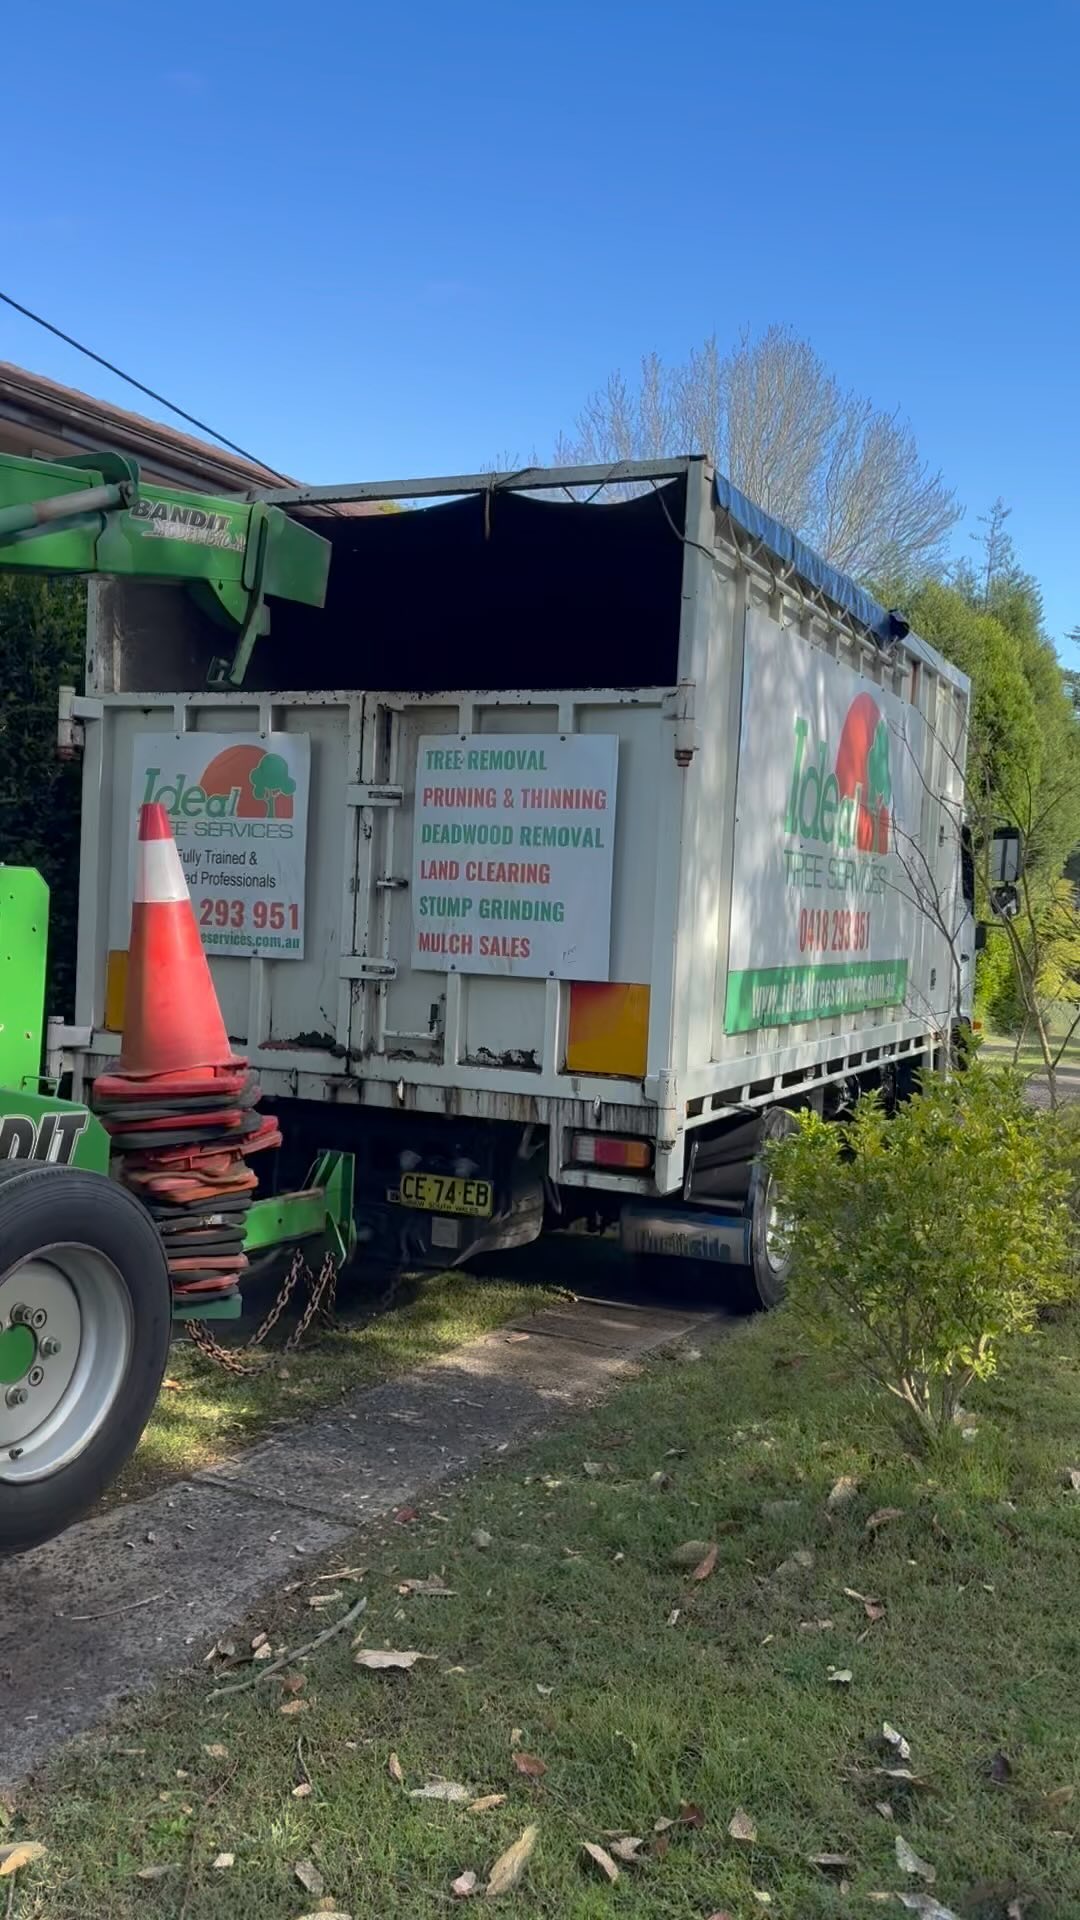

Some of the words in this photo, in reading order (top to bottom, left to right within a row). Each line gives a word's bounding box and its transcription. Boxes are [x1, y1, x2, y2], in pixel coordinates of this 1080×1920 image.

[129, 498, 232, 530] BANDIT
[426, 750, 462, 770] TREE
[467, 750, 548, 770] REMOVAL
[138, 768, 241, 818] Ideal
[784, 716, 863, 848] Ideal
[423, 787, 497, 808] PRUNING
[503, 788, 515, 809] &
[521, 788, 608, 810] THINNING
[194, 821, 294, 839] SERVICES
[421, 823, 514, 845] DEADWOOD
[519, 825, 605, 848] REMOVAL
[176, 848, 201, 866] Fully
[205, 849, 246, 865] Trained
[249, 851, 258, 865] &
[783, 849, 824, 889] TREE
[201, 871, 277, 888] Professionals
[420, 860, 460, 881] LAND
[465, 861, 551, 884] CLEARING
[200, 898, 245, 928] 293
[253, 900, 299, 930] 951
[419, 896, 473, 917] STUMP
[479, 898, 565, 922] GRINDING
[418, 932, 473, 954] MULCH
[479, 935, 531, 958] SALES
